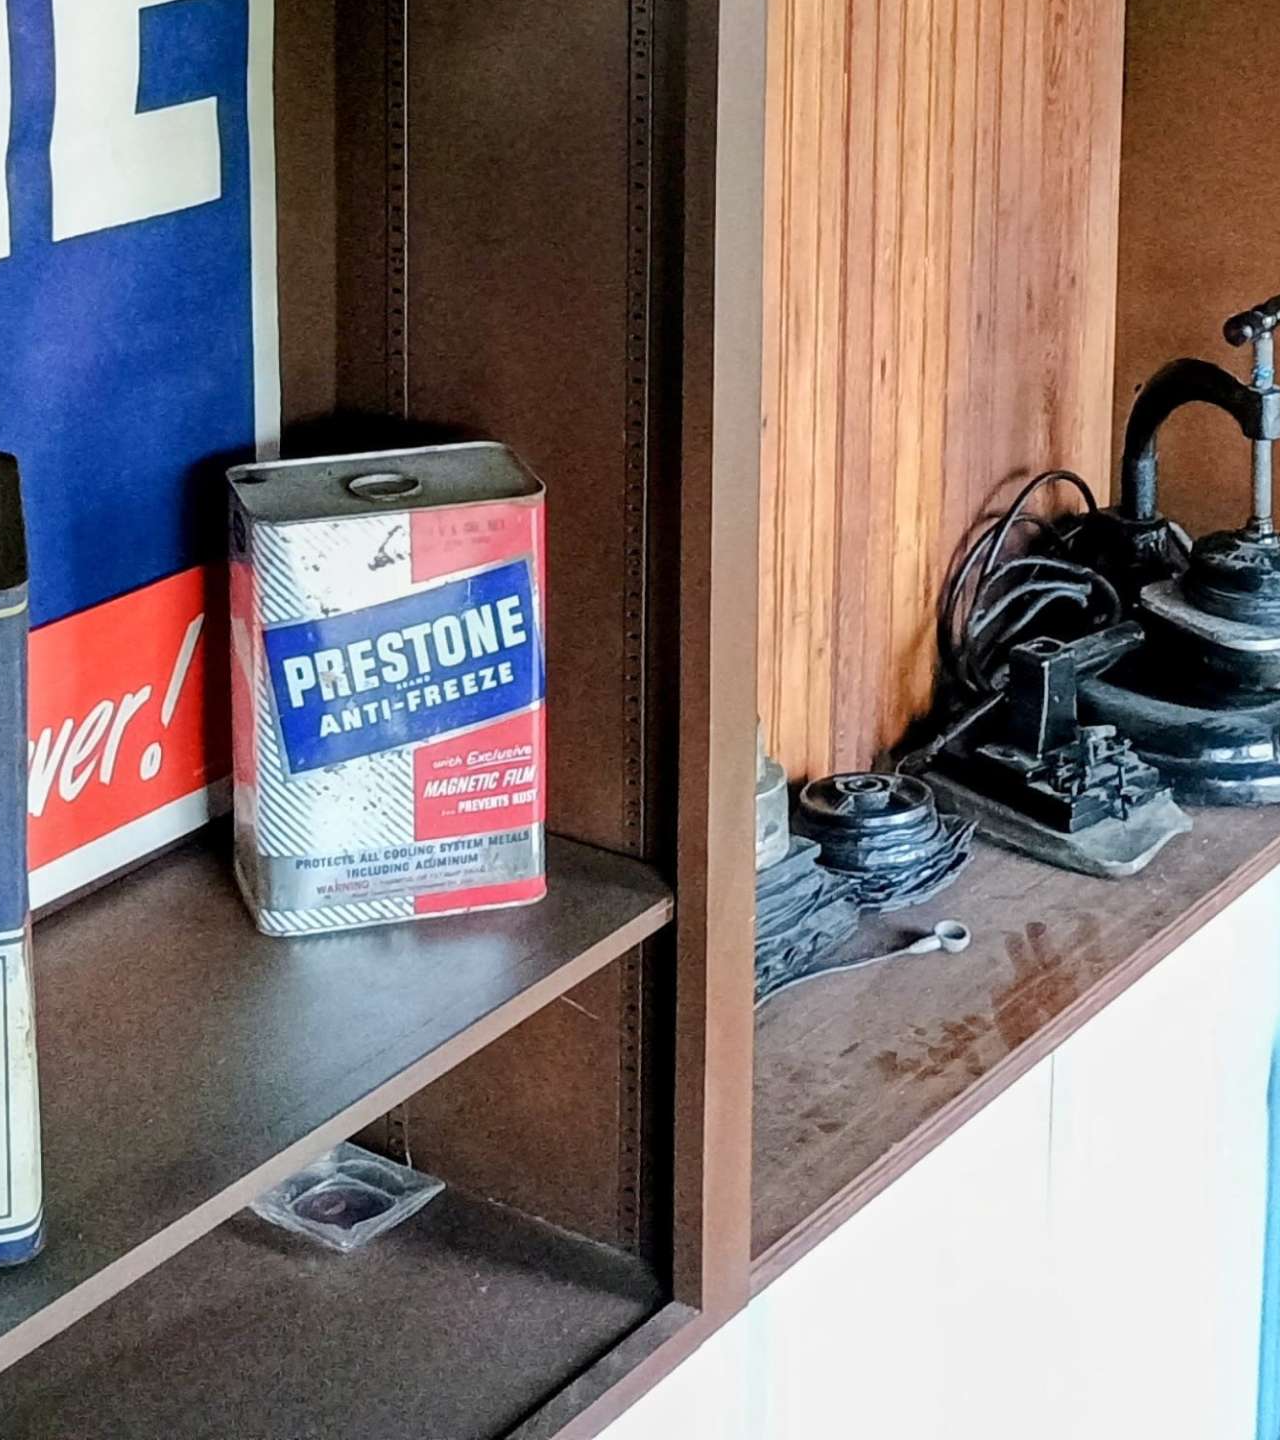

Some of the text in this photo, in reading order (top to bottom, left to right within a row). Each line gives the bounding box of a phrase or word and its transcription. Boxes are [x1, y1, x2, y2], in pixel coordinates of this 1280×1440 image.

[282, 594, 527, 709] PRESTONE
[28, 613, 205, 817] ver!
[320, 661, 514, 737] ANTI-FREEZE
[466, 744, 532, 766] Exclusive
[423, 765, 537, 799] MAGNETIC FILM
[457, 793, 510, 814] PREVENTS
[295, 830, 529, 870] PROTECTS ALL COOLING SYSTEM METALS
[346, 862, 410, 879] INCLUDING
[415, 853, 479, 870] ALUMINUM
